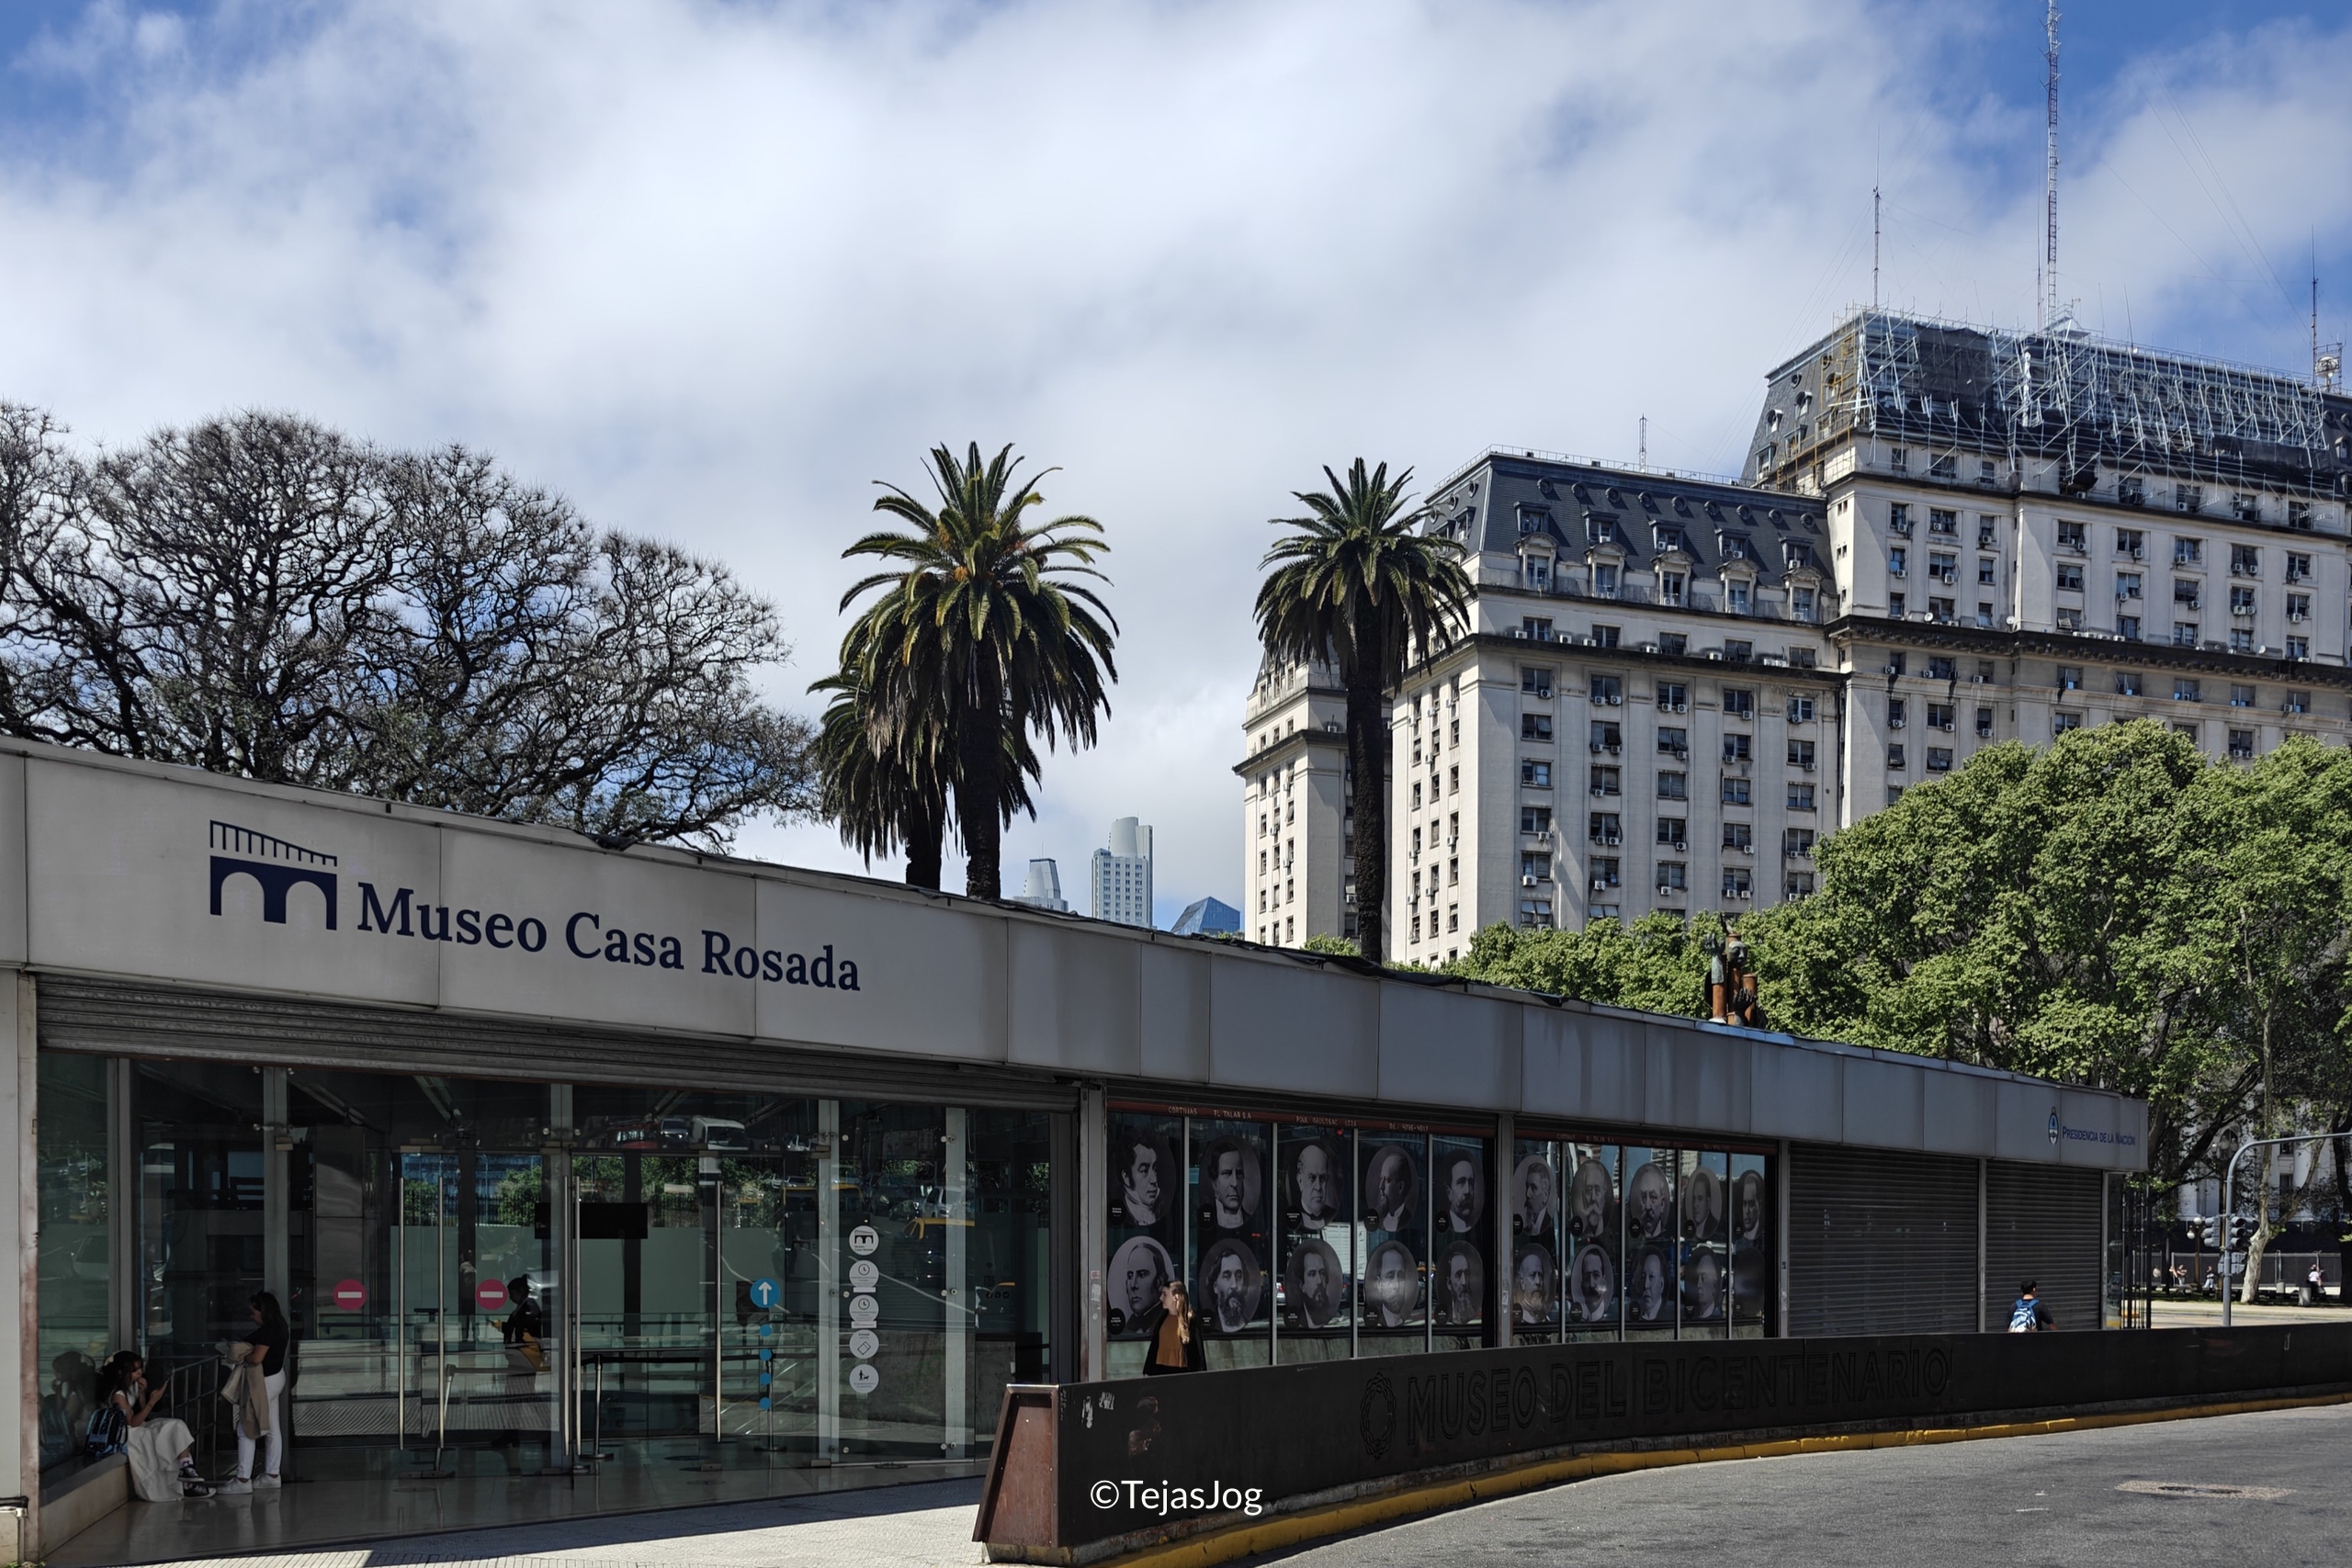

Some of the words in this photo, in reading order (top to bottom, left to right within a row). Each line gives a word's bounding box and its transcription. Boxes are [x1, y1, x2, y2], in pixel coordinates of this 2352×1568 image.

[357, 882, 548, 953] Museo
[565, 911, 684, 971] Casa
[701, 930, 861, 991] Rosada
[2062, 1126, 2098, 1142] PRESIDENCIA
[2099, 1132, 2107, 1143] DE
[2108, 1133, 2114, 1144] LA
[1407, 1365, 1537, 1446] MUSEO
[1550, 1360, 1626, 1423] DEL
[1644, 1347, 1951, 1415] BICENTENARIO
